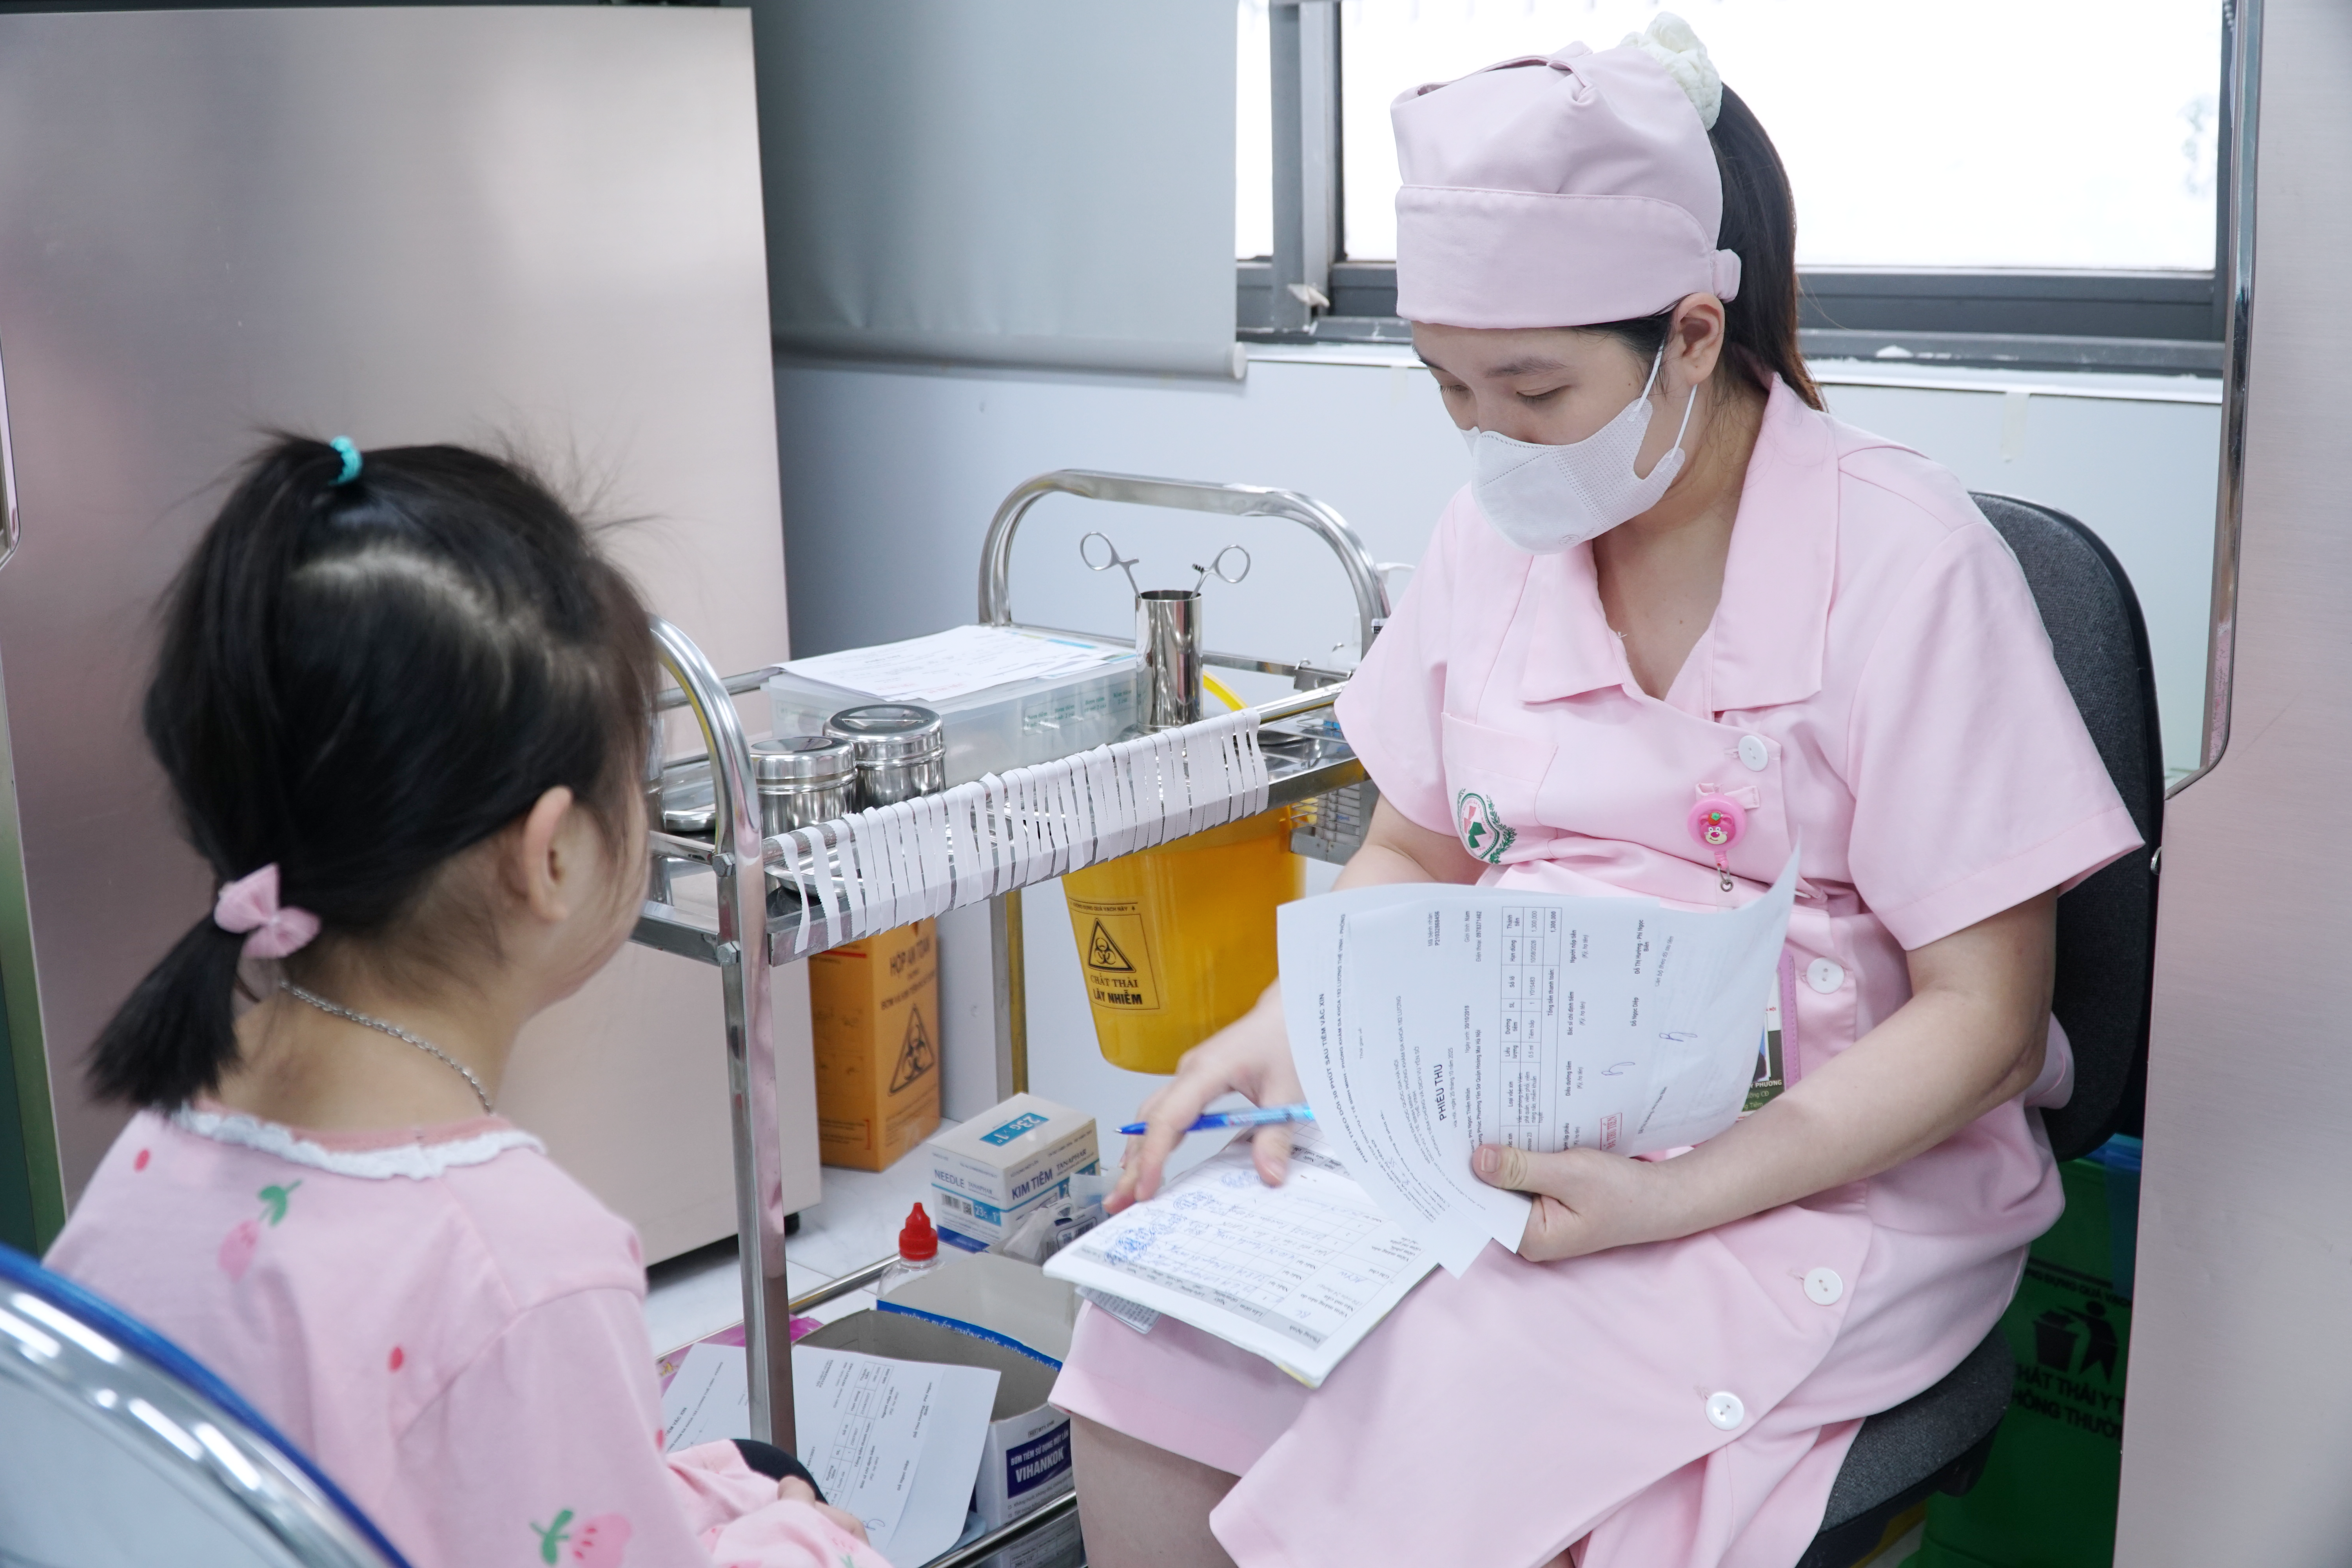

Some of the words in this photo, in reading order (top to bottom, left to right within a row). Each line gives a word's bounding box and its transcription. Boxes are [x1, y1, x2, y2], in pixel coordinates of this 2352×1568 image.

[1091, 973, 1109, 986] CHẤT
[1111, 976, 1139, 987] THẢI
[1093, 988, 1105, 1002] LÂY
[1107, 989, 1143, 1005] NHIỄM
[1319, 1027, 1328, 1046] TIÊM
[1325, 1067, 1336, 1089] PHÚT
[1434, 1064, 1443, 1087] THU
[1755, 1079, 1782, 1088] PHƯƠNG
[1332, 1090, 1338, 1100] 30
[1434, 1088, 1447, 1121] PHIẾU
[1009, 1116, 1040, 1130] 23G
[1341, 1117, 1354, 1138] THEO
[1352, 1140, 1368, 1163] PHIẾU
[935, 1169, 965, 1188] NEEDLE
[967, 1181, 992, 1195] TANAPHAR
[1012, 1182, 1030, 1200] KIM
[1031, 1168, 1053, 1190] TIÊM
[1056, 1149, 1086, 1171] TANAPHAR
[2058, 1376, 2096, 1406] THẢI
[2100, 1391, 2113, 1410] Y
[1011, 1455, 1022, 1466] BƠM
[1023, 1450, 1034, 1461] TIÊM
[1016, 1446, 1064, 1483] VIHANKOK
